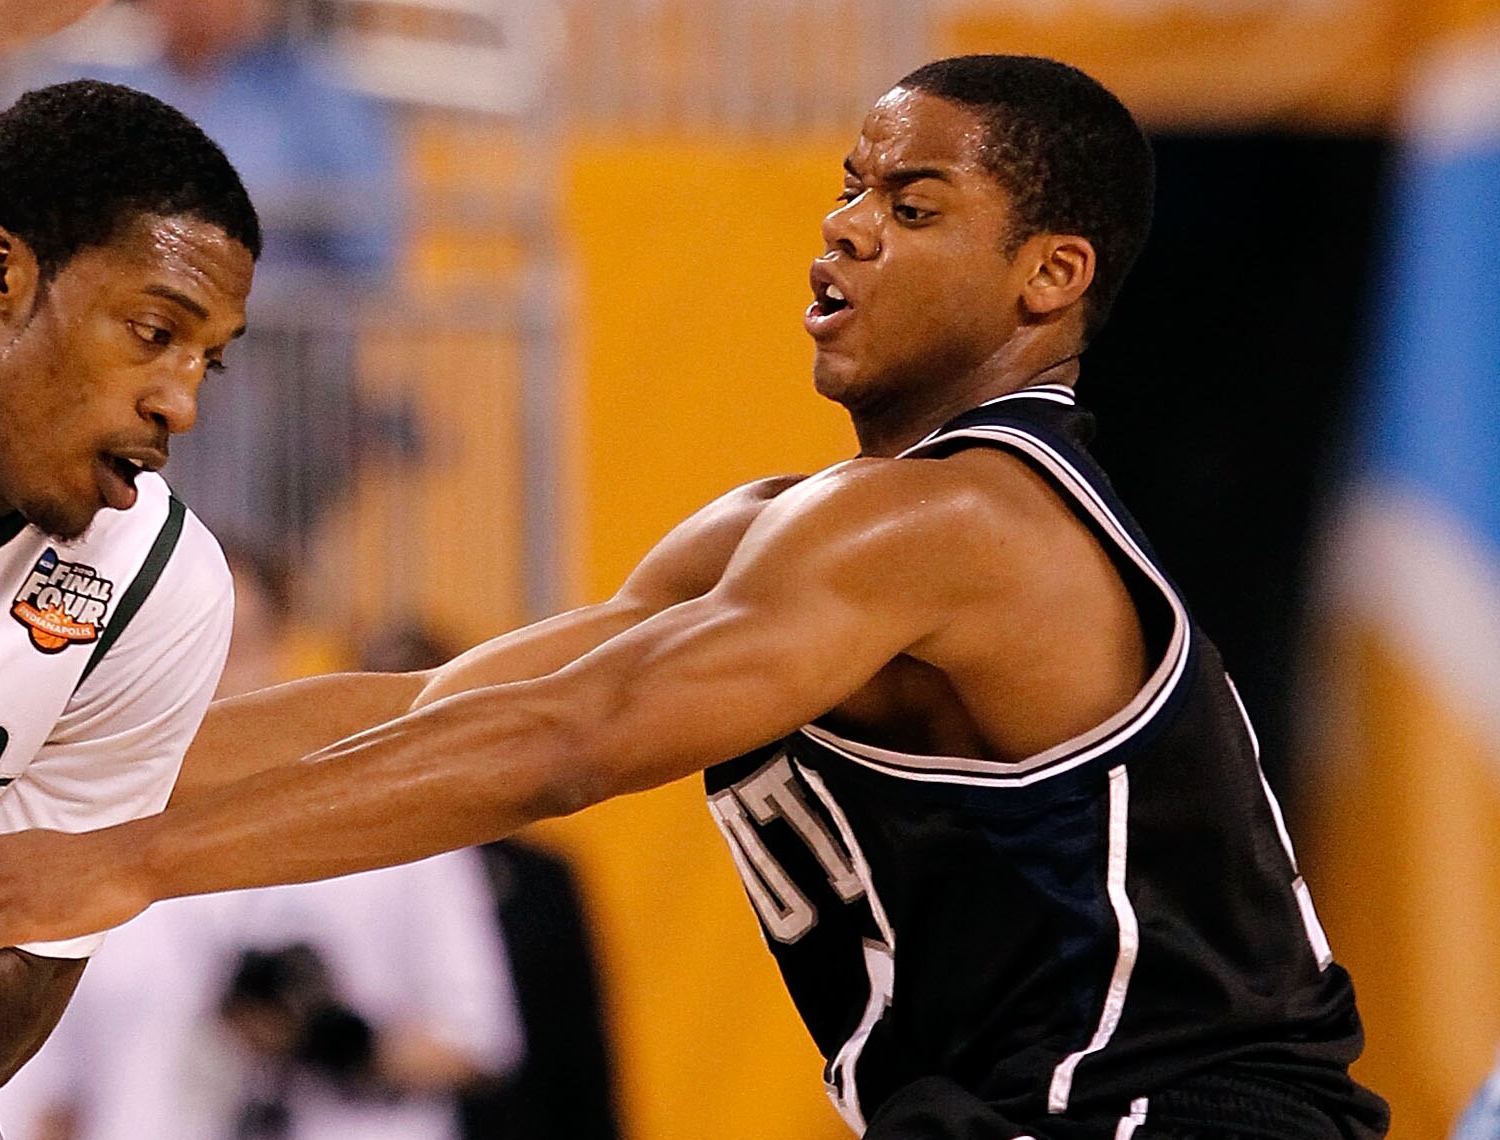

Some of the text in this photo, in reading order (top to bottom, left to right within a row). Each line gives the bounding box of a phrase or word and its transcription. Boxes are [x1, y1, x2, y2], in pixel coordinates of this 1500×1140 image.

[15, 571, 107, 628] FOUR
[48, 563, 112, 601] FINAL
[18, 605, 92, 637] INDIANAPOLIS
